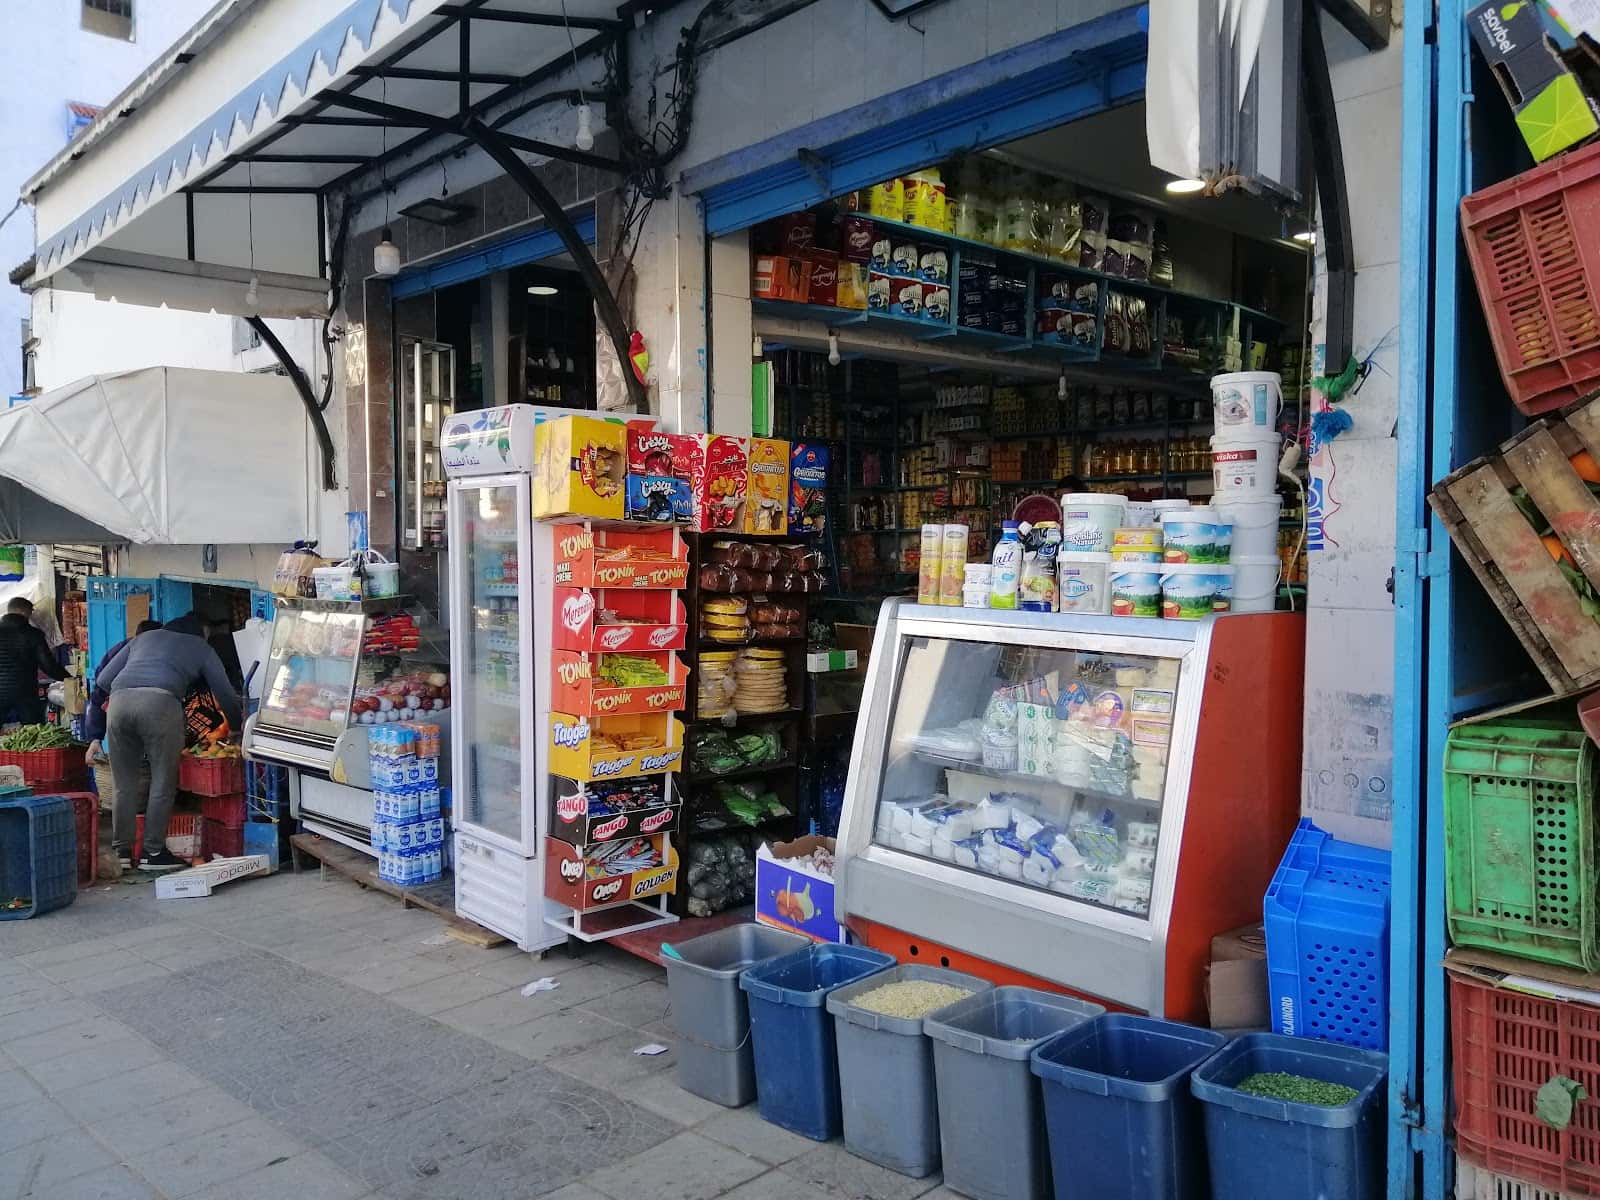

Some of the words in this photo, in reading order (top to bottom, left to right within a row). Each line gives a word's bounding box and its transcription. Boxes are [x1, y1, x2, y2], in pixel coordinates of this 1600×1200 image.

[553, 723, 589, 746] Tagger
[593, 757, 635, 777] Tagger
[640, 752, 680, 771] Tagger
[557, 798, 587, 815] TANGO
[593, 818, 626, 838] TANGO
[641, 810, 673, 831] TANGO
[635, 870, 673, 895] GOLDEN
